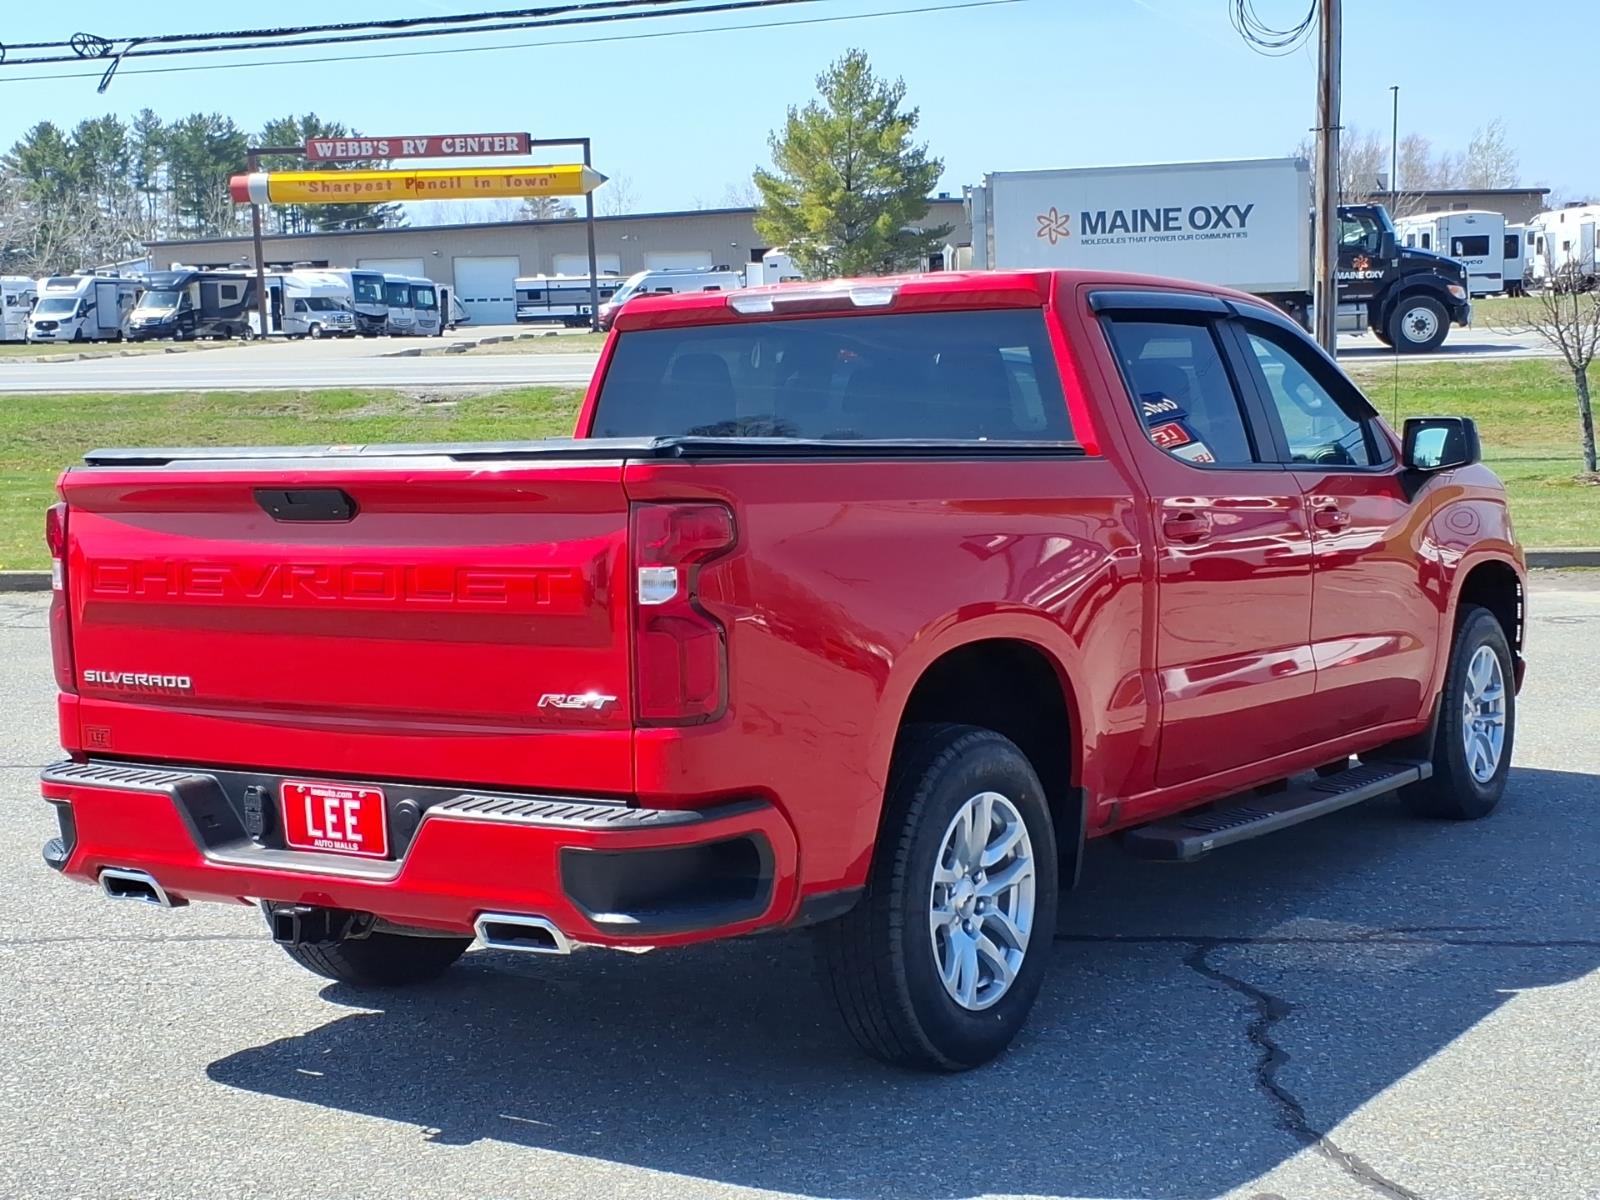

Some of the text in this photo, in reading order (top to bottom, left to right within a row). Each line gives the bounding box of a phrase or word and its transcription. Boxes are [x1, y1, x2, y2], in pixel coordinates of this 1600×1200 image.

[314, 137, 519, 157] WEBB'S RV CENTER
[405, 176, 462, 190] Pencil
[474, 176, 490, 188] in
[504, 173, 557, 188] Town"
[1080, 204, 1254, 235] MAINE OXY
[1081, 237, 1126, 246] MOLECULES
[1195, 232, 1248, 241] COMMUNITIES
[1365, 270, 1384, 279] OXY
[93, 561, 573, 605] CHEVROLET
[83, 670, 191, 688] SILVERADO
[537, 692, 617, 710] RST
[304, 795, 363, 841] LEE
[314, 839, 358, 851] AUTO MALLS
